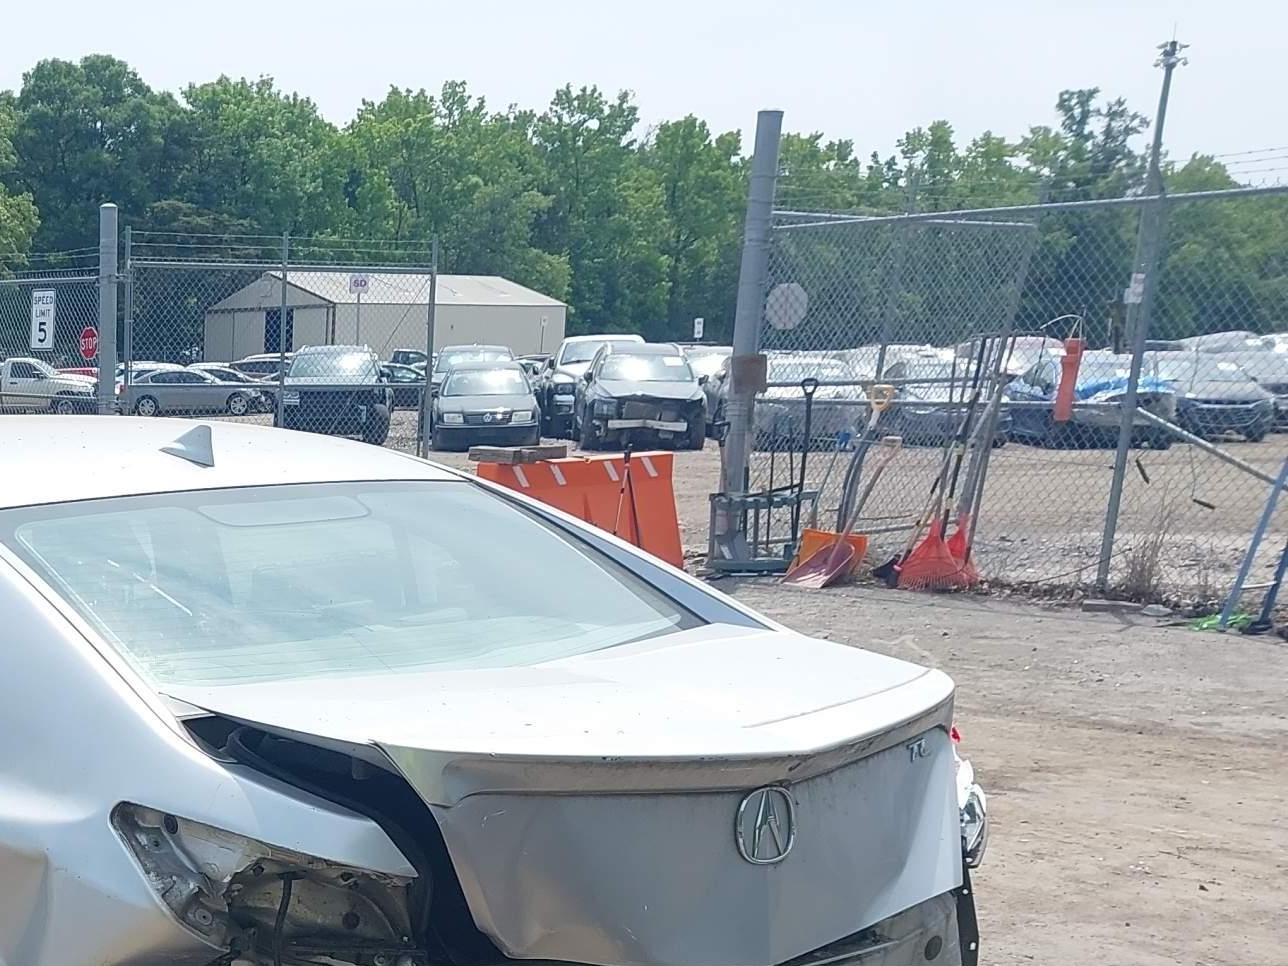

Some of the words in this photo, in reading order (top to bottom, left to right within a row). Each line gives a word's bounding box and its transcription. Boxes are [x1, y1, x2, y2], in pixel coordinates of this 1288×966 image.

[353, 279, 367, 288] SD
[34, 295, 54, 305] SPEED
[35, 308, 51, 318] LIMIT
[37, 321, 47, 343] 5
[81, 336, 97, 351] STOP
